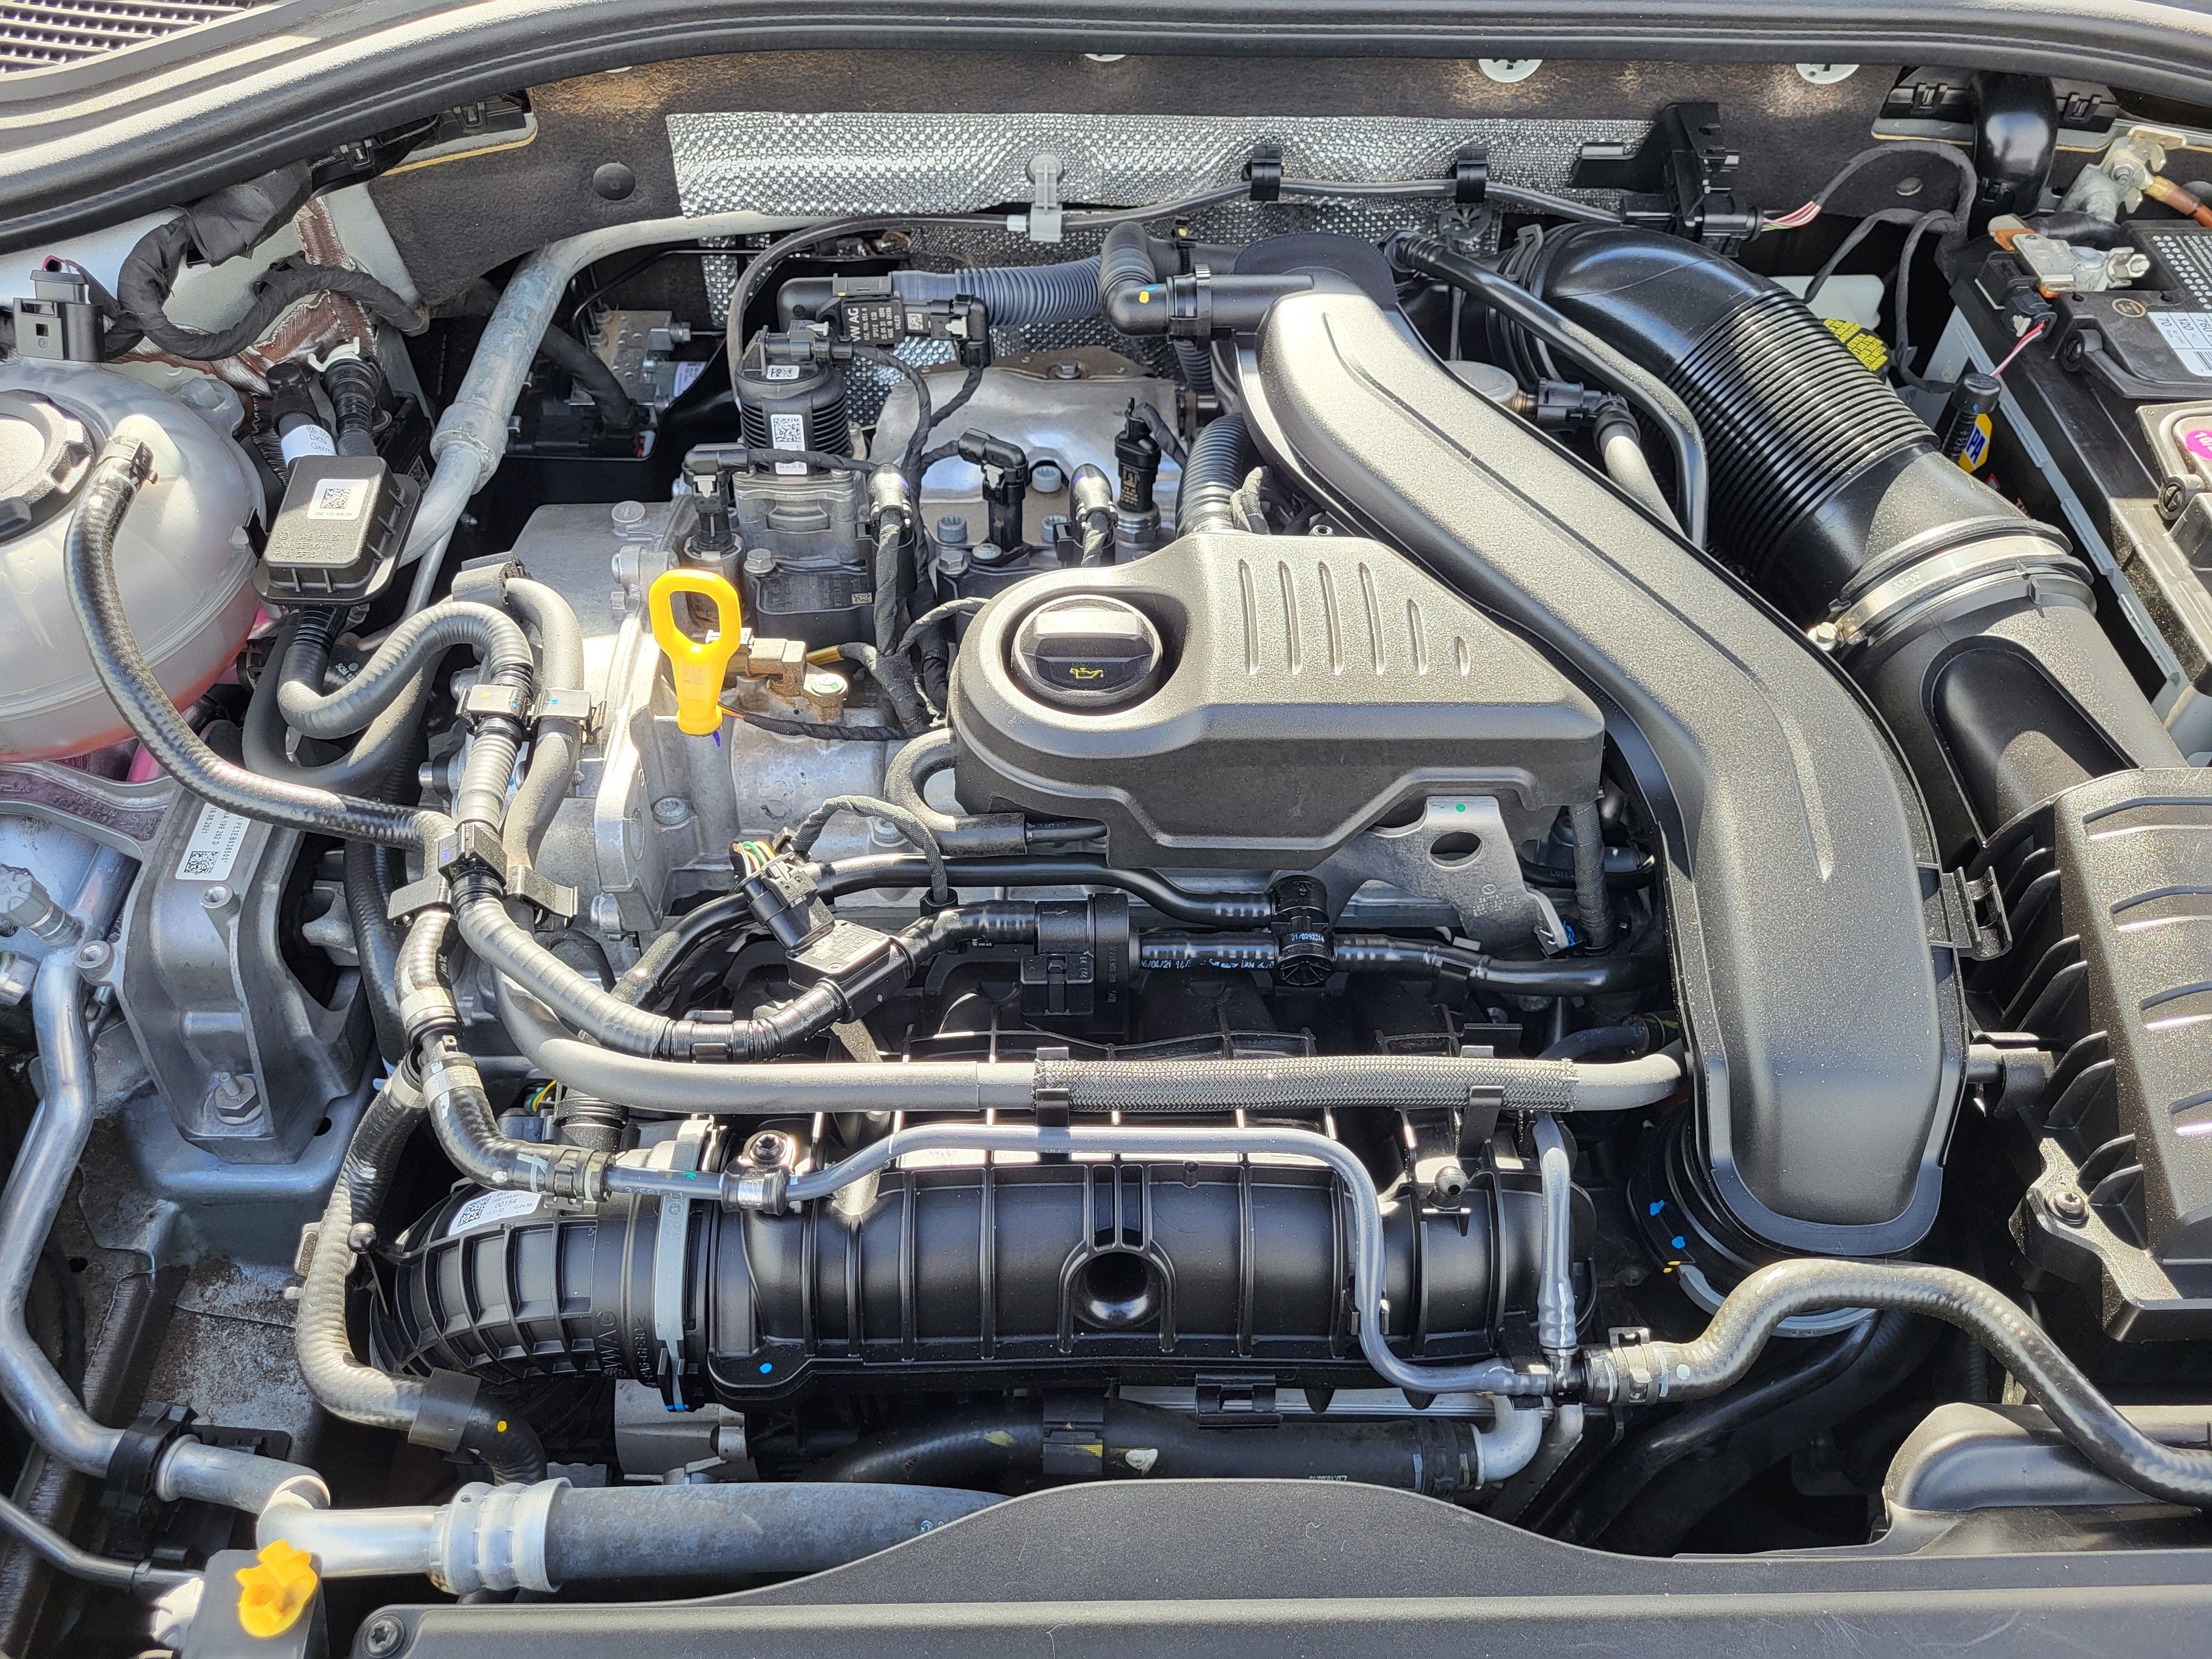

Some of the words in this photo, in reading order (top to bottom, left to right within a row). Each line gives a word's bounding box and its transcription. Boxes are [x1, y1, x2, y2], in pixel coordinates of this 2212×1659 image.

[847, 307, 860, 324] AG
[2158, 318, 2172, 326] 70
[2178, 318, 2194, 330] 120
[2197, 319, 2212, 332] 760
[849, 325, 861, 342] VW
[310, 434, 327, 445] DKN
[311, 443, 334, 454] Germ
[495, 1198, 518, 1208] 00154
